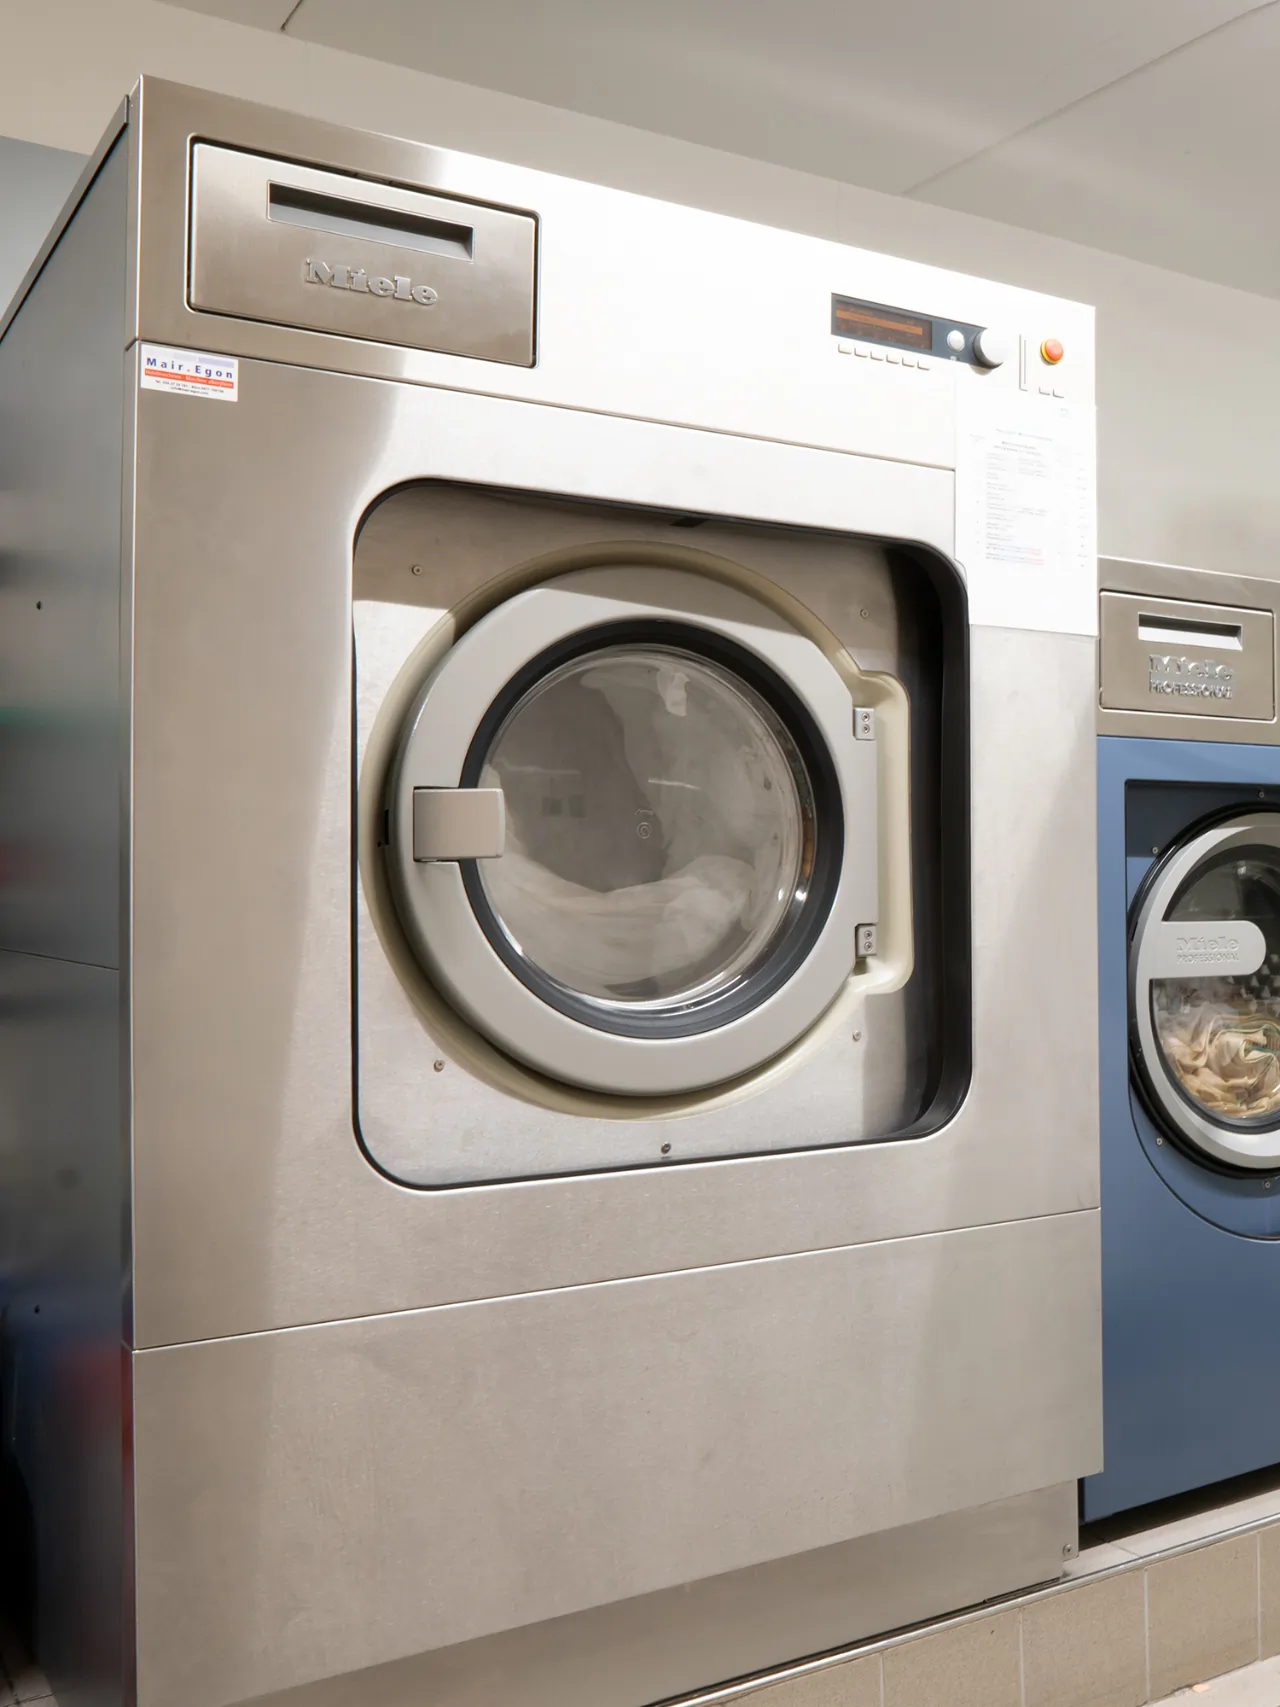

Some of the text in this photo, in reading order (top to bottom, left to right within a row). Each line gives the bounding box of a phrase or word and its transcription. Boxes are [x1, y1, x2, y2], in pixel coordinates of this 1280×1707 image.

[307, 258, 437, 305] Miele
[1149, 654, 1235, 681] Miele
[1149, 679, 1233, 700] PROFESSIONAL
[1176, 936, 1240, 953] Miele
[1176, 951, 1240, 965] PROFESSIONAL
